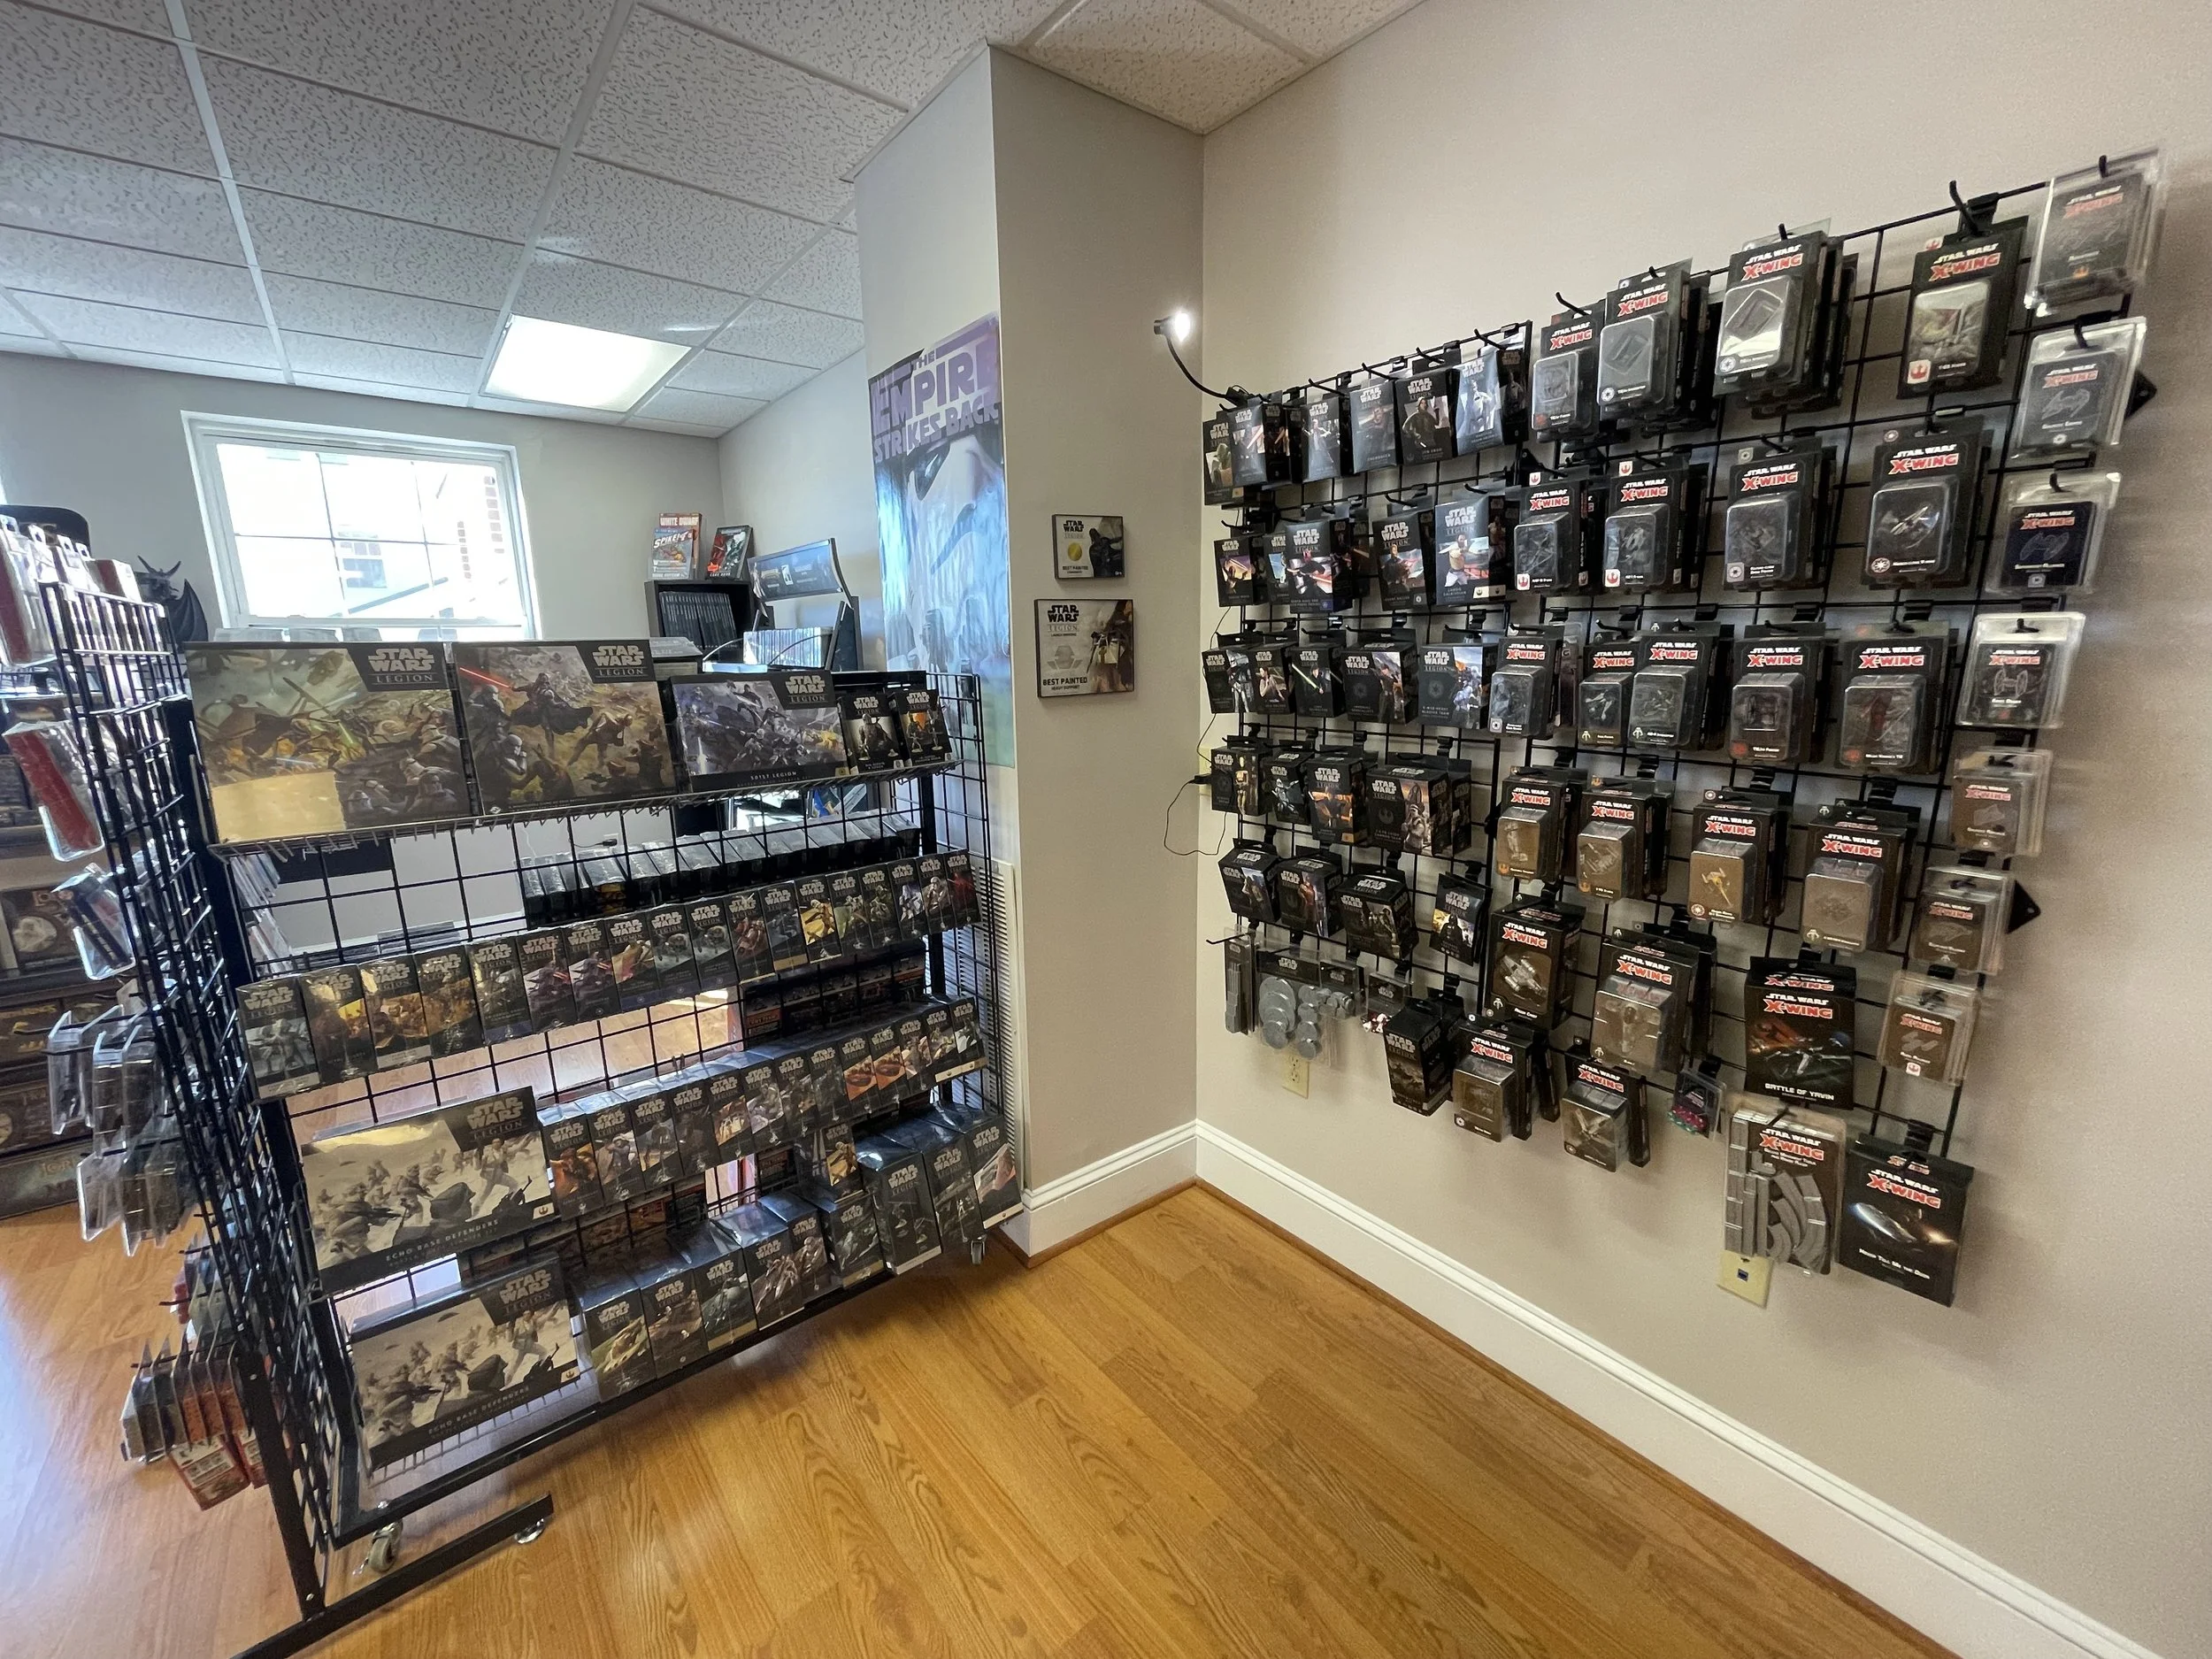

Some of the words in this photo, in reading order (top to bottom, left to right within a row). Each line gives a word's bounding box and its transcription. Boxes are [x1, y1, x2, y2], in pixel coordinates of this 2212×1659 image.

[1745, 254, 1772, 265] STAR
[1773, 244, 1801, 257] WARS
[1933, 252, 1965, 264] STAR
[1966, 243, 1999, 256] WARS
[1741, 253, 1803, 282] X-WING
[1929, 252, 2001, 281] X-WING
[1621, 291, 1643, 301] STAR
[1643, 284, 1666, 294] WARS
[1617, 292, 1669, 317] X-WING
[1552, 327, 1571, 336] STAR
[1571, 322, 1590, 332] WARS
[1549, 329, 1592, 350] X-WING
[911, 350, 935, 370] THE
[1408, 384, 1432, 394] WARS
[1409, 378, 1432, 388] STAR
[874, 412, 941, 464] STRIKES
[945, 390, 999, 437] BACK
[1893, 449, 1924, 458] STAR
[1924, 444, 1957, 454] WARS
[1888, 453, 1959, 474] X-WING
[1744, 467, 1770, 477] STAR
[1770, 464, 1796, 472] WARS
[1741, 472, 1798, 491] X-WING
[1620, 487, 1668, 502] X-WING
[1529, 496, 1570, 511] X-WING
[1446, 506, 1476, 518] STAR
[660, 517, 678, 526] WHITE
[680, 517, 699, 526] DWARF
[1382, 522, 1409, 533] STAR
[1445, 515, 1476, 527] WARS
[1294, 529, 1319, 538] STAR
[1381, 530, 1408, 541] WARS
[1294, 536, 1319, 545] WARS
[1048, 605, 1079, 614] STAR
[1048, 613, 1079, 623] WARS
[368, 649, 434, 660] STAR
[593, 645, 644, 657] STAR
[1649, 649, 1698, 660] X-WING
[370, 659, 432, 671] WARS
[594, 656, 642, 666] WARS
[1747, 655, 1803, 667] X-WING
[1859, 655, 1924, 668] X-WING
[785, 675, 825, 685] STAR
[786, 684, 824, 694] WARS
[1315, 768, 1340, 777] STAR
[1315, 773, 1340, 782] WARS
[1371, 780, 1396, 789] STAR
[1592, 805, 1634, 819] X-WING
[1705, 820, 1755, 836] X-WING
[1852, 836, 1879, 845] WARS
[1821, 839, 1882, 857] X-WING
[691, 905, 720, 914] STAR
[691, 911, 719, 921] WARS
[651, 918, 681, 928] WARS
[652, 912, 681, 921] STAR
[611, 919, 642, 928] STAR
[611, 926, 641, 937] WARS
[1502, 926, 1547, 949] X-WING
[1525, 927, 1546, 936] WARS
[474, 944, 512, 956] STAR
[473, 952, 511, 963] WARS
[1620, 956, 1643, 964] STAR
[1643, 961, 1671, 971] WARS
[1617, 959, 1671, 985] X-WING
[244, 987, 294, 1001] STAR
[1766, 993, 1798, 1002] STAR
[1798, 996, 1829, 1005] WARS
[244, 996, 292, 1010] WARS
[1763, 999, 1832, 1018] X-WING
[673, 1087, 703, 1098] STAR
[1764, 1083, 1794, 1094] BATTLE
[1809, 1091, 1834, 1101] YAVIN
[467, 1097, 523, 1113] STAR
[673, 1094, 702, 1106] WARS
[467, 1110, 522, 1129] WARS
[473, 1120, 522, 1141] LEGION
[550, 1123, 583, 1134] STAR
[550, 1131, 583, 1143] WARS
[1763, 1129, 1790, 1139] STAR
[1791, 1134, 1821, 1145] WARS
[1760, 1133, 1823, 1160] X-WING
[888, 1164, 918, 1179] STAR
[888, 1174, 918, 1188] WARS
[1870, 1170, 1902, 1184] STAR
[1903, 1179, 1938, 1194] WARS
[1867, 1173, 1940, 1209] X-WING
[386, 1248, 412, 1261] ECHO
[500, 1270, 551, 1286] STAR
[500, 1281, 549, 1303] WARS
